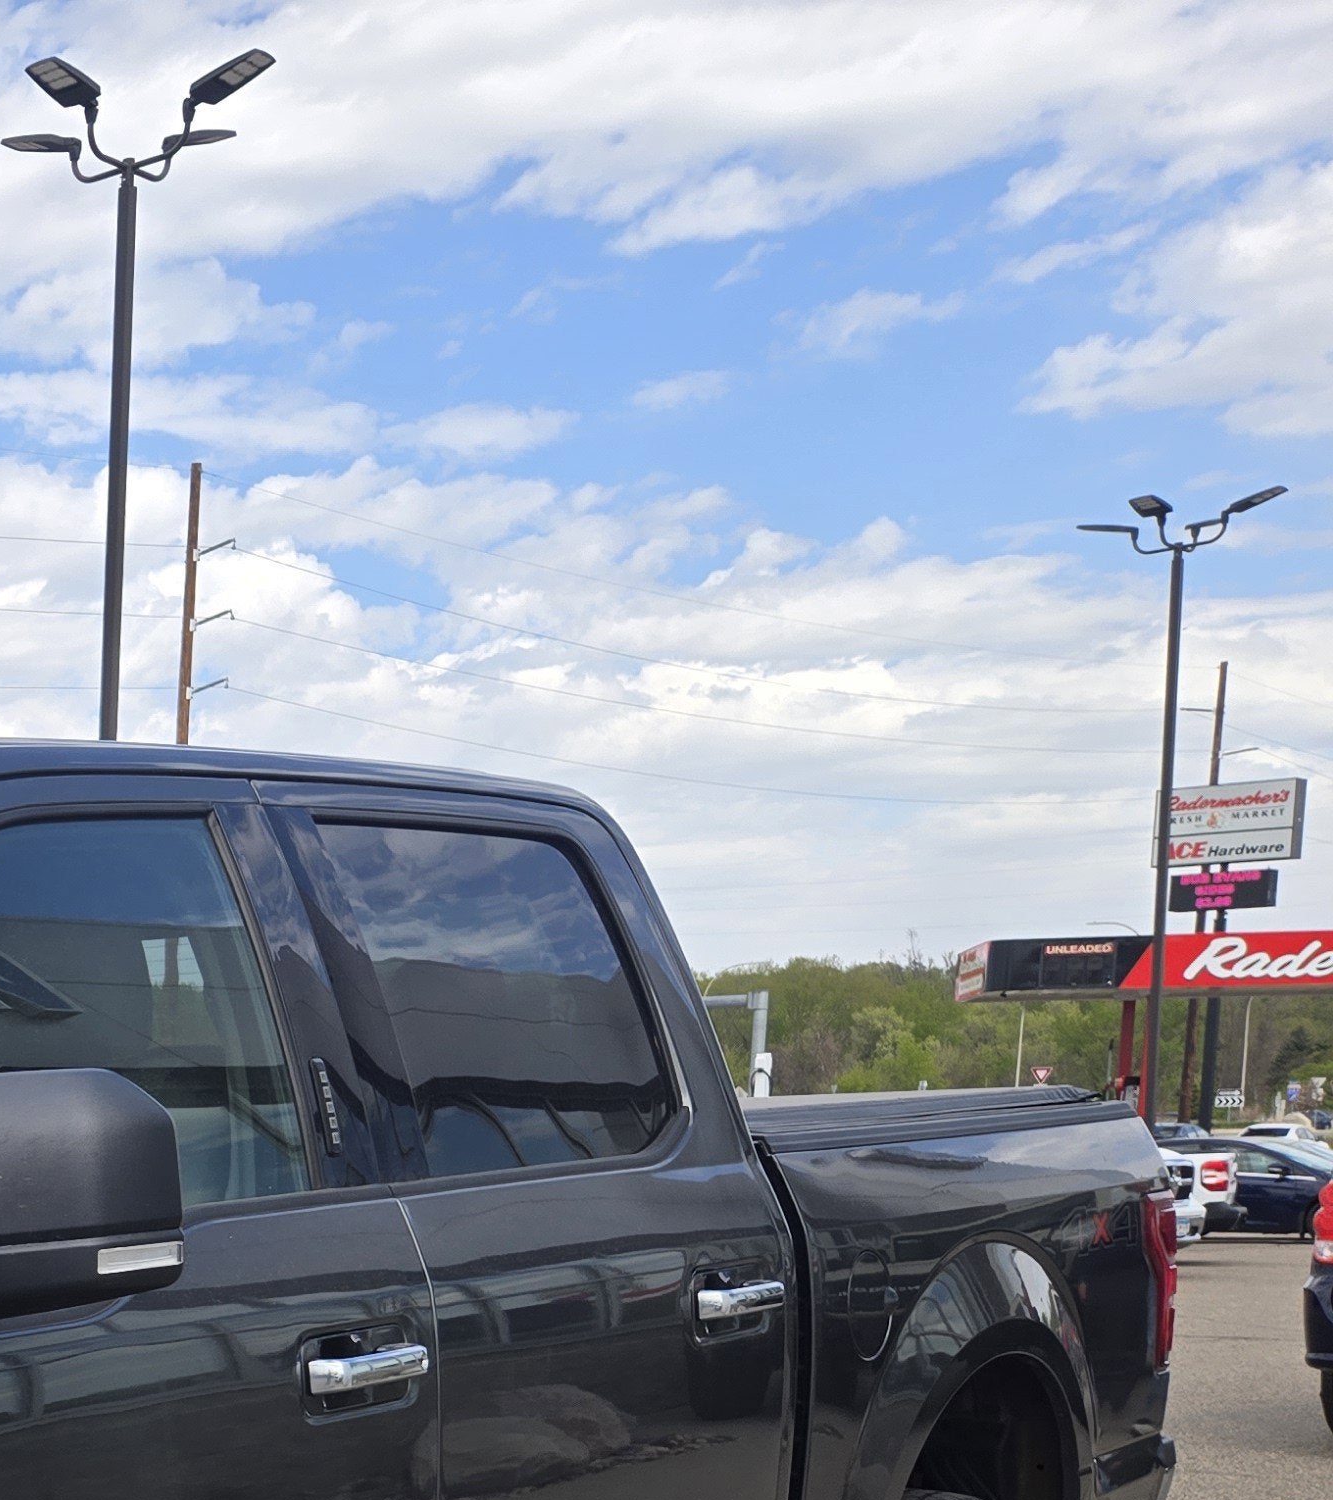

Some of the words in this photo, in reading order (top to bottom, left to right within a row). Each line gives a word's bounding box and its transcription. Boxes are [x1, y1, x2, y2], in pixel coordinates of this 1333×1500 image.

[1231, 808, 1285, 819] MARKET
[1208, 843, 1285, 857] Hardware
[1046, 944, 1113, 955] UNLEADED
